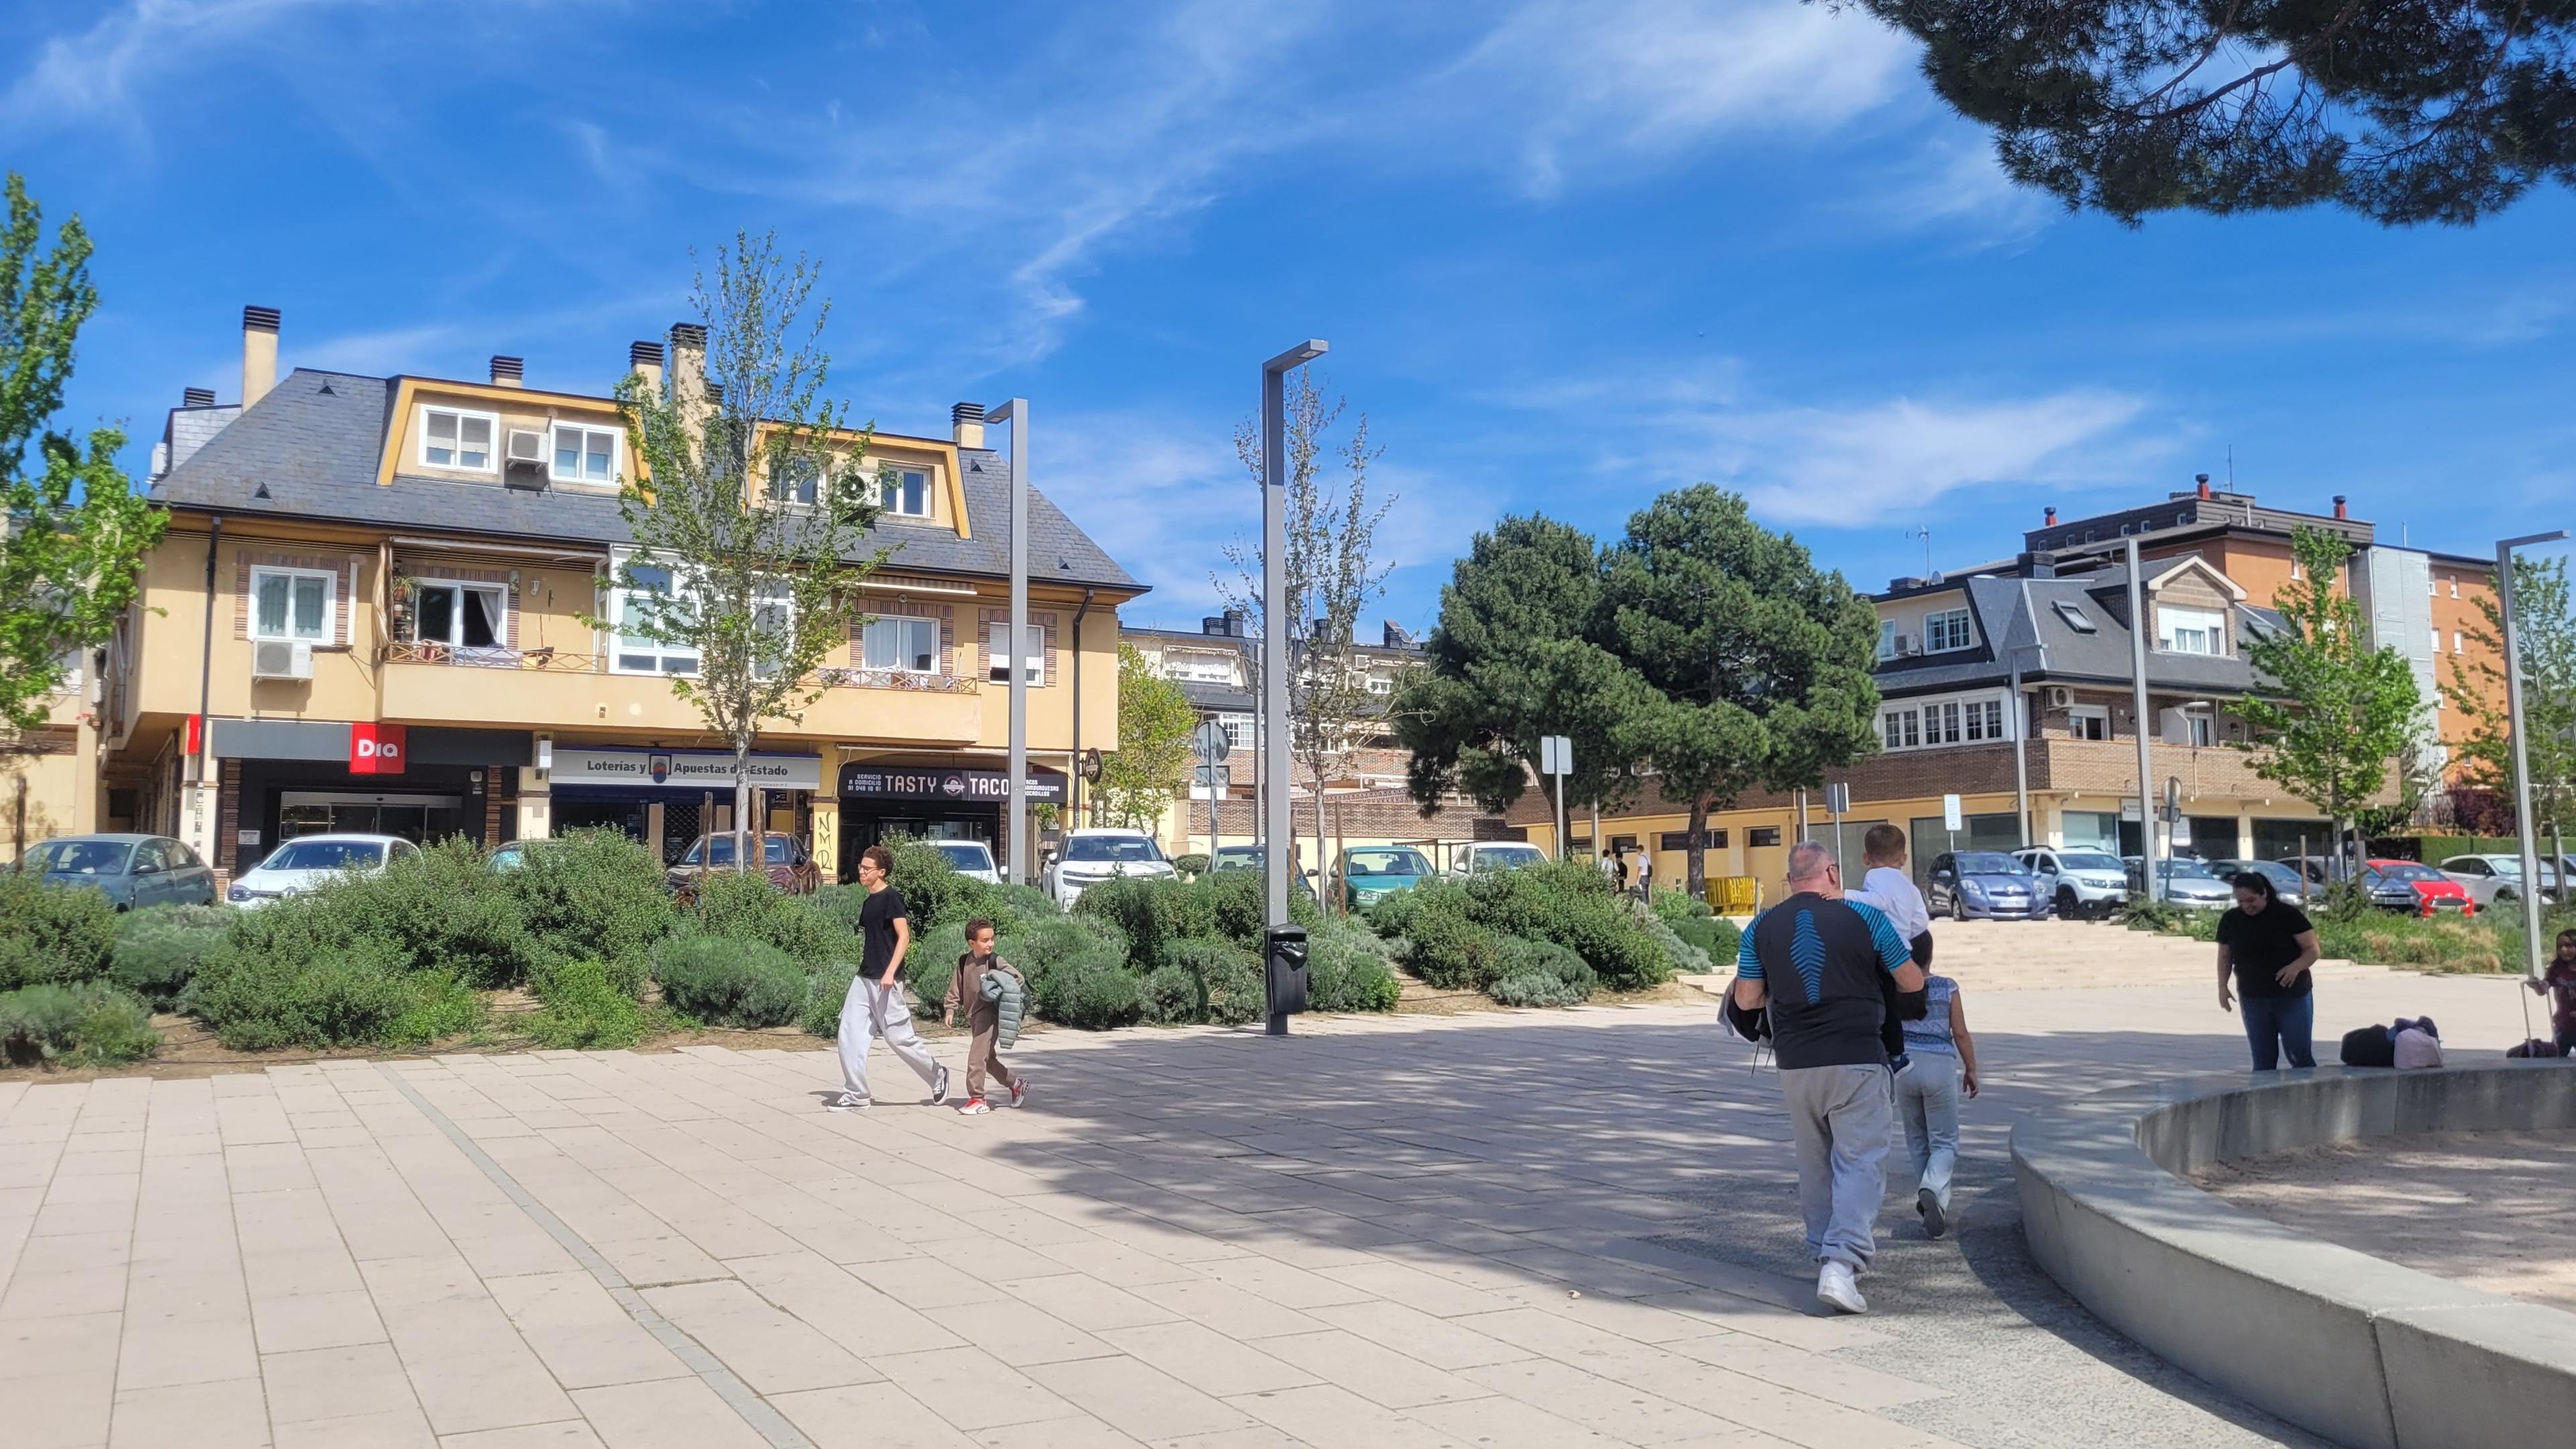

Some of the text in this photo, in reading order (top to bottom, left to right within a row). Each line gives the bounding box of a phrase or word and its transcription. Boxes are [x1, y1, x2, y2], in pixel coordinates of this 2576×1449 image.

[587, 760, 636, 771] Loterías
[639, 763, 646, 774] y
[674, 763, 727, 775] Apuestas
[750, 765, 788, 775] Estado
[885, 775, 937, 793] TASTY
